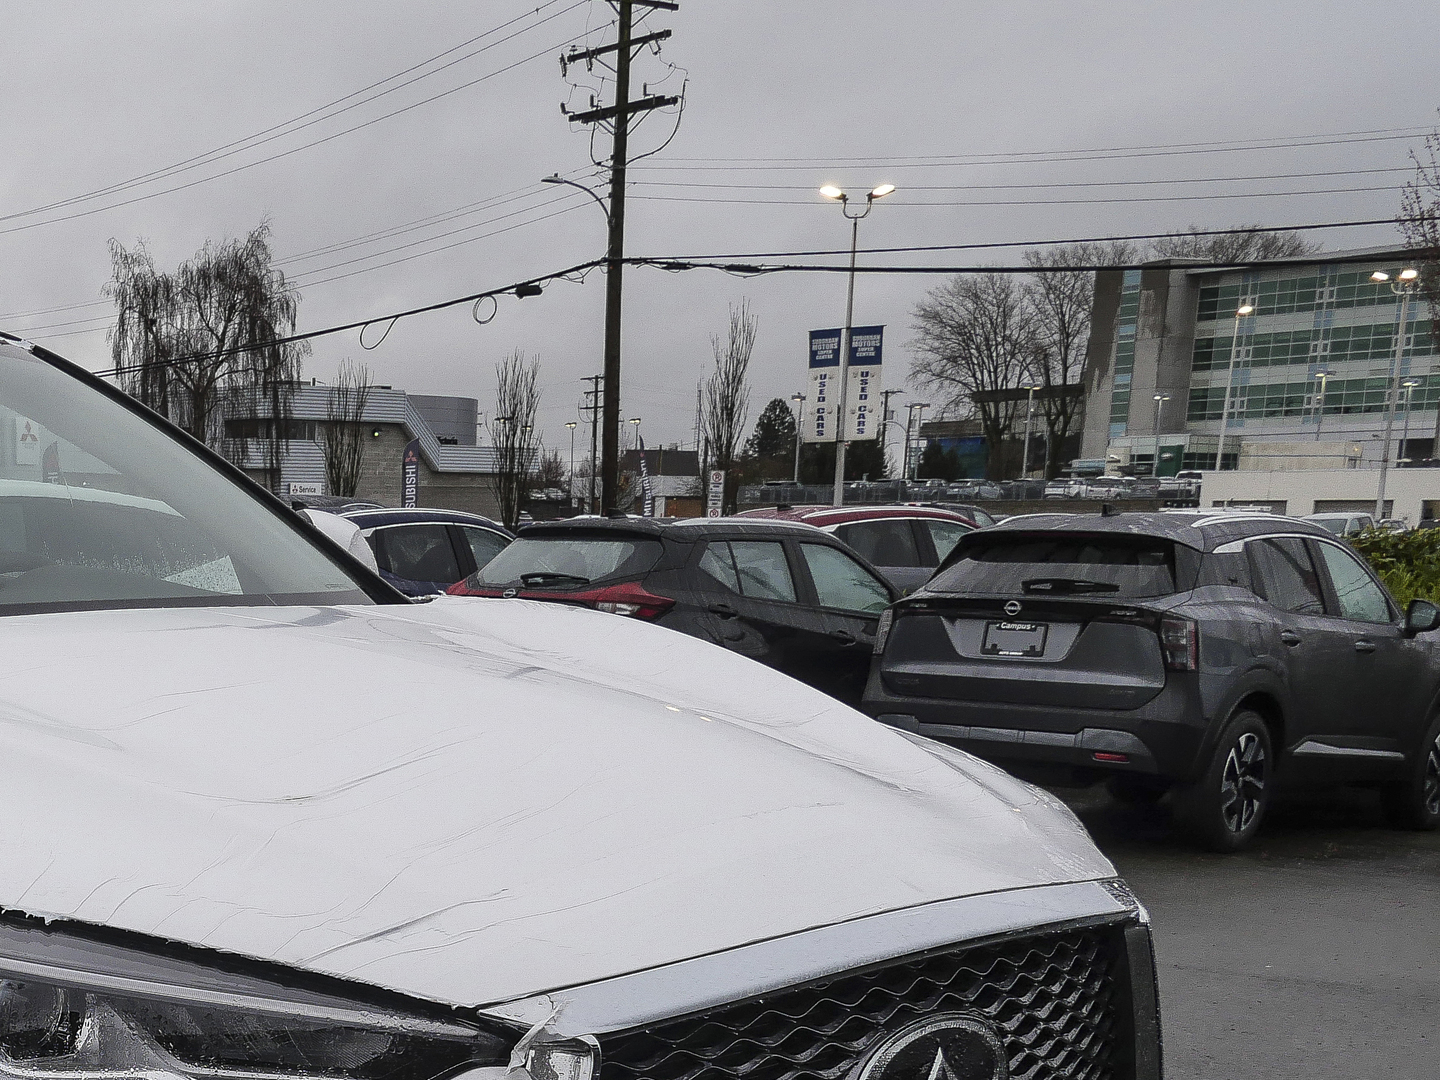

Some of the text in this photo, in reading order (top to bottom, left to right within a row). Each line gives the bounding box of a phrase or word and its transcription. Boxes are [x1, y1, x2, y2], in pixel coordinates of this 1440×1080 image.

[816, 373, 827, 436] USED CARS
[856, 371, 869, 434] USED CARS
[298, 485, 317, 494] Service
[405, 465, 416, 509] SUBISHI
[1000, 622, 1032, 631] Campus
